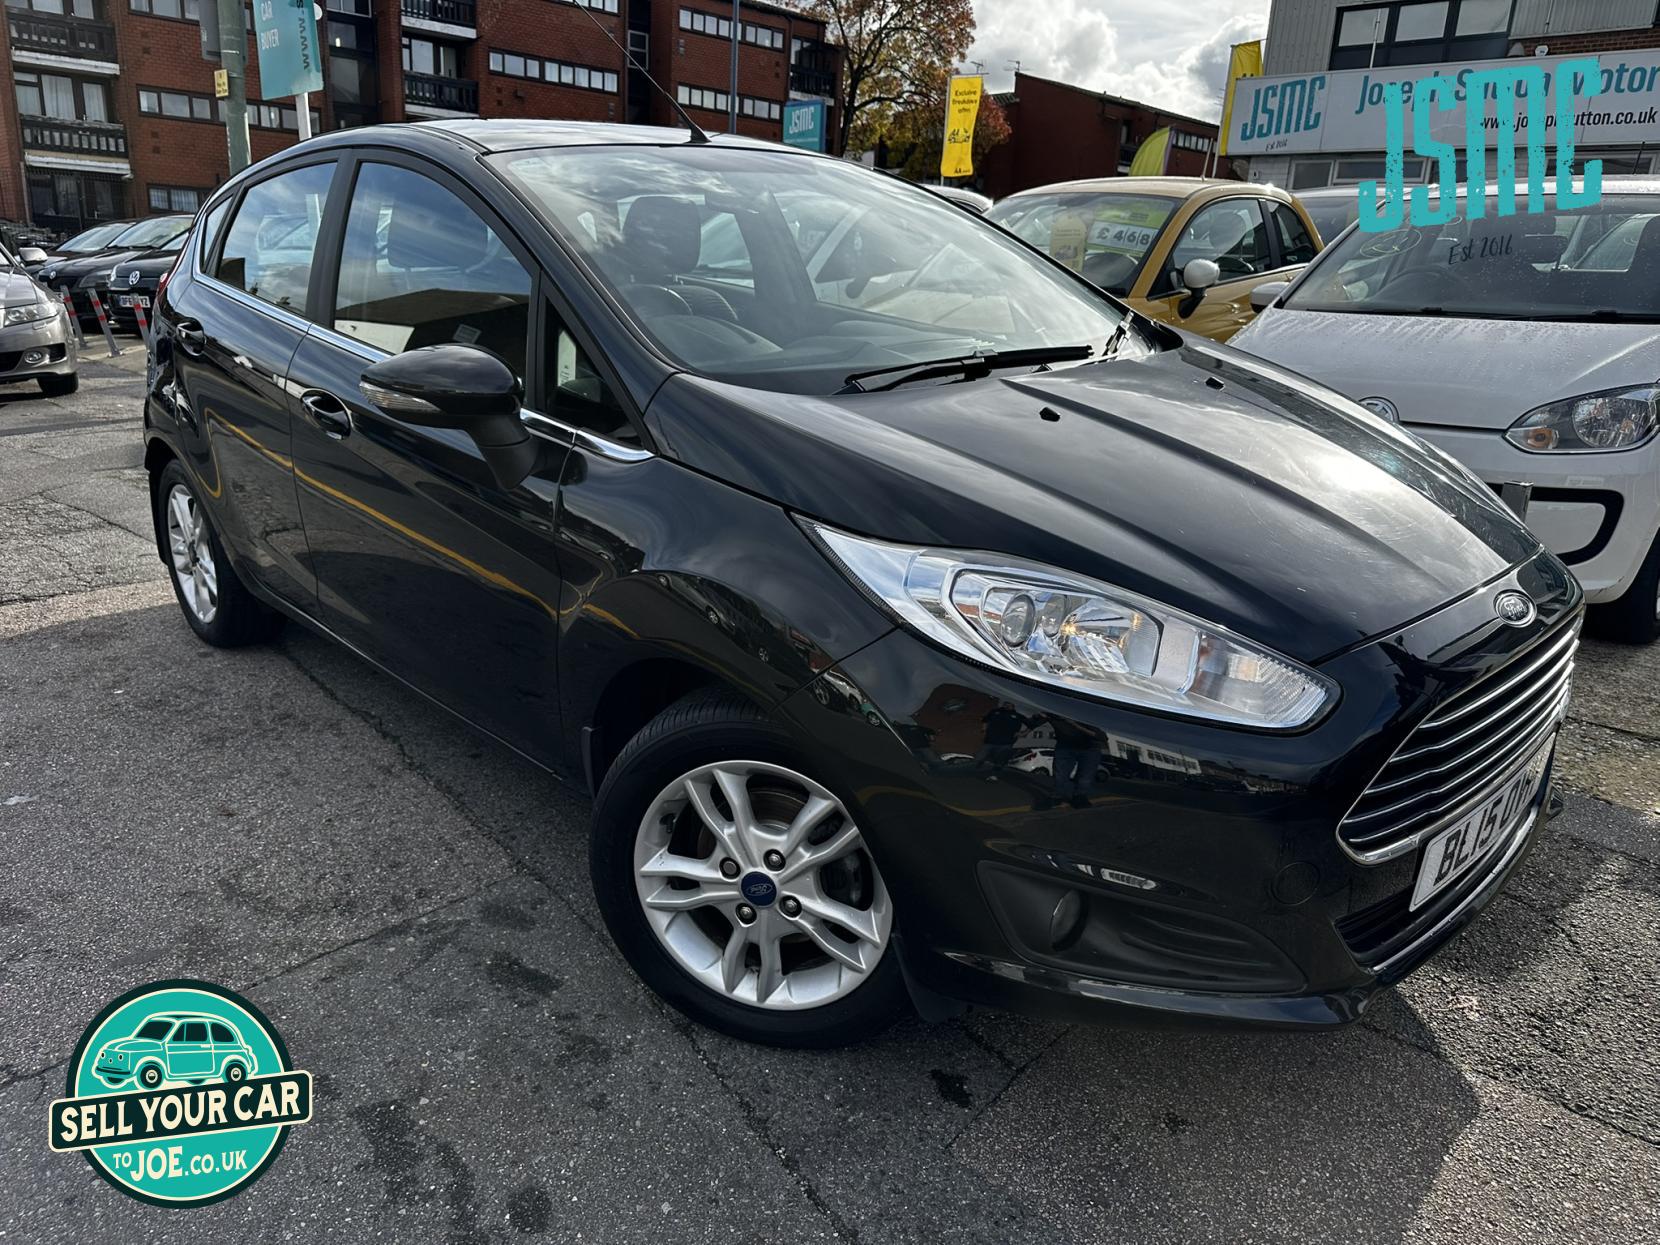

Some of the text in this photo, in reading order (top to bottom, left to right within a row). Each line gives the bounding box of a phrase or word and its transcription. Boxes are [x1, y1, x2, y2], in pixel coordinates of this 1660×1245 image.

[260, 28, 279, 50] BUYER
[789, 106, 814, 134] JSMC
[1240, 75, 1326, 141] JSMC
